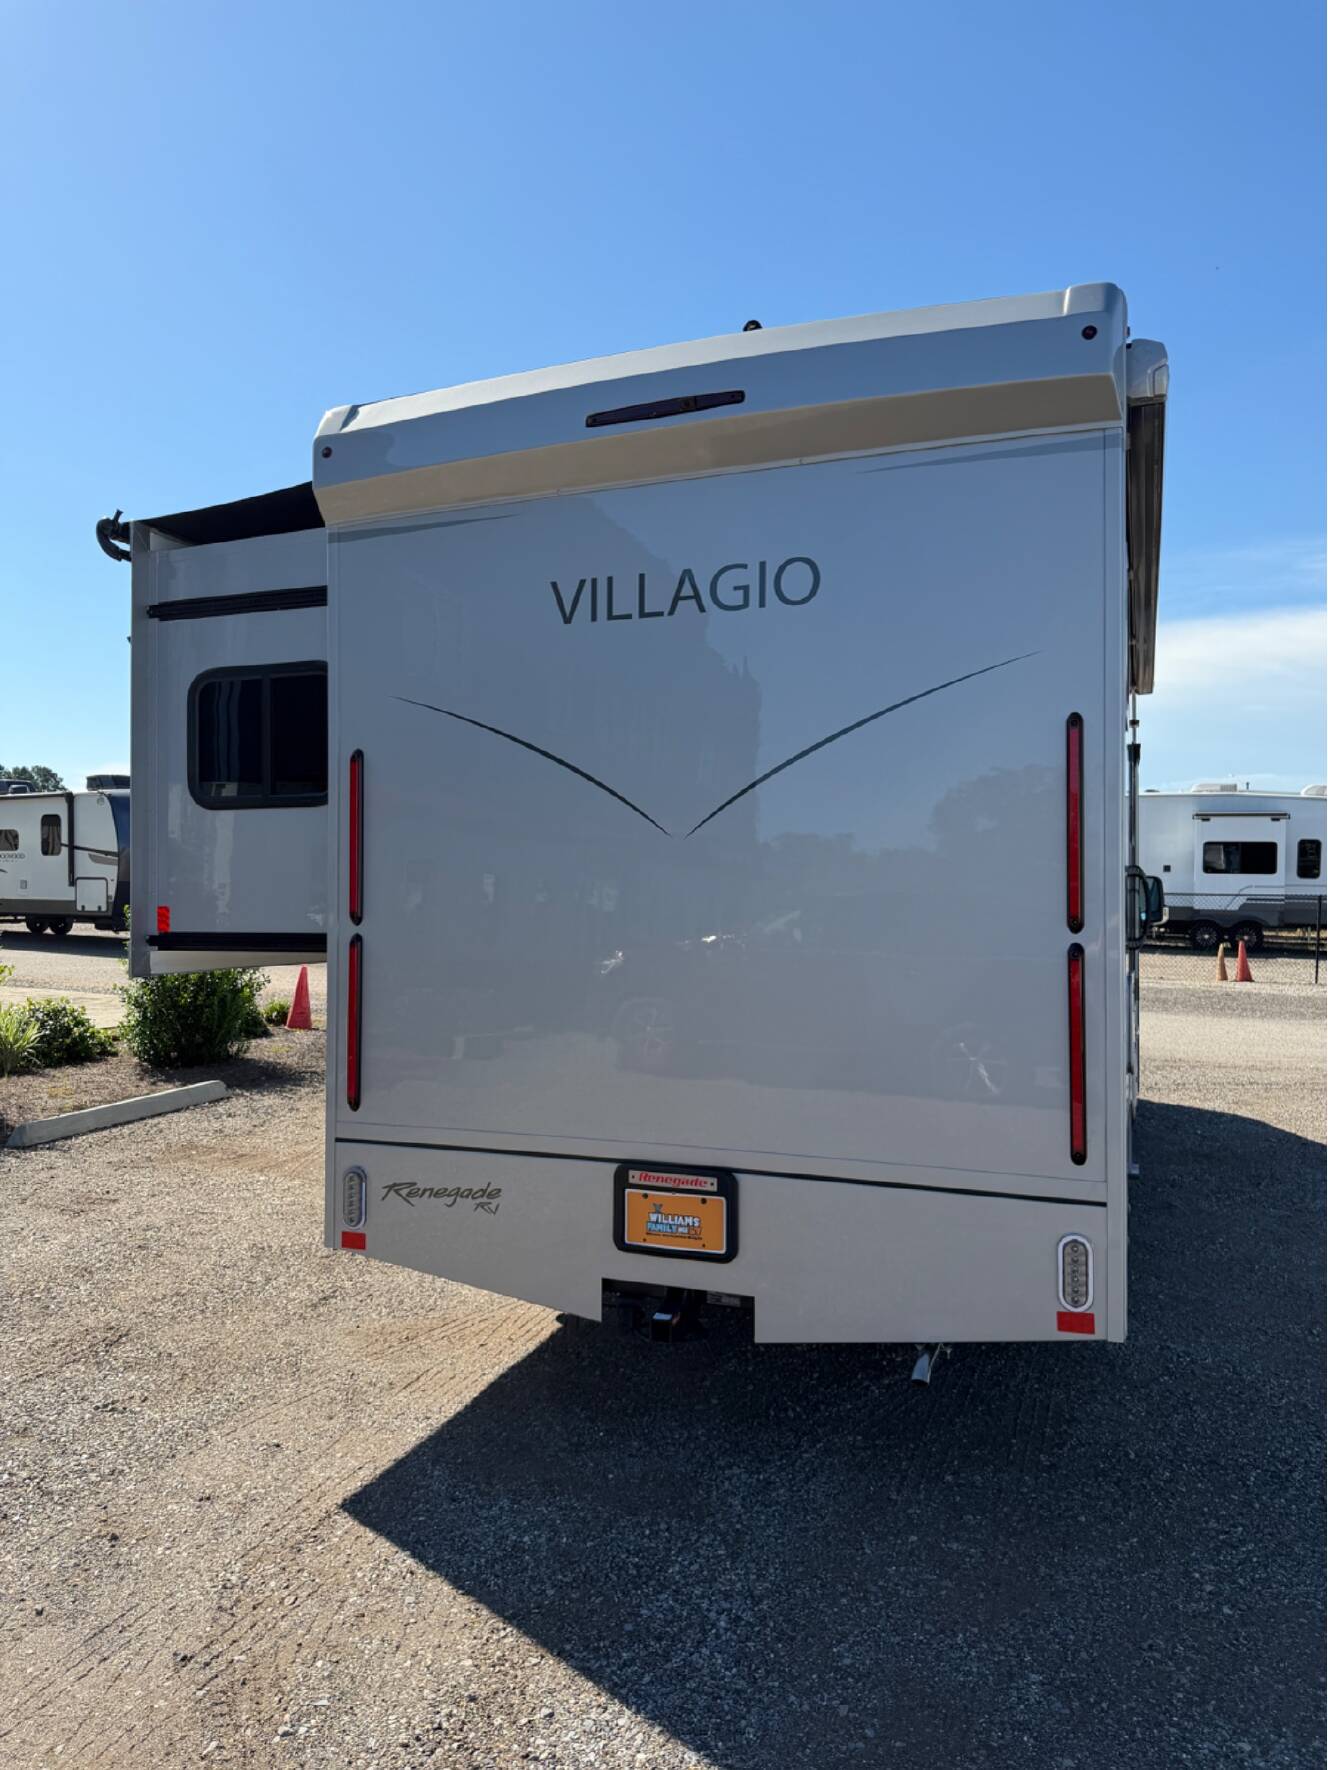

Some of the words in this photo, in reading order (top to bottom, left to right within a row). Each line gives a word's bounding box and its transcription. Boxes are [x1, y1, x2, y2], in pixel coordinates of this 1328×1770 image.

[550, 556, 821, 624] VILLAGIO
[639, 1172, 708, 1188] Renegade
[381, 1182, 502, 1207] Renegade
[473, 1201, 500, 1215] RV
[648, 1212, 701, 1227] WILLIAMS
[647, 1222, 677, 1234] FAMILY
